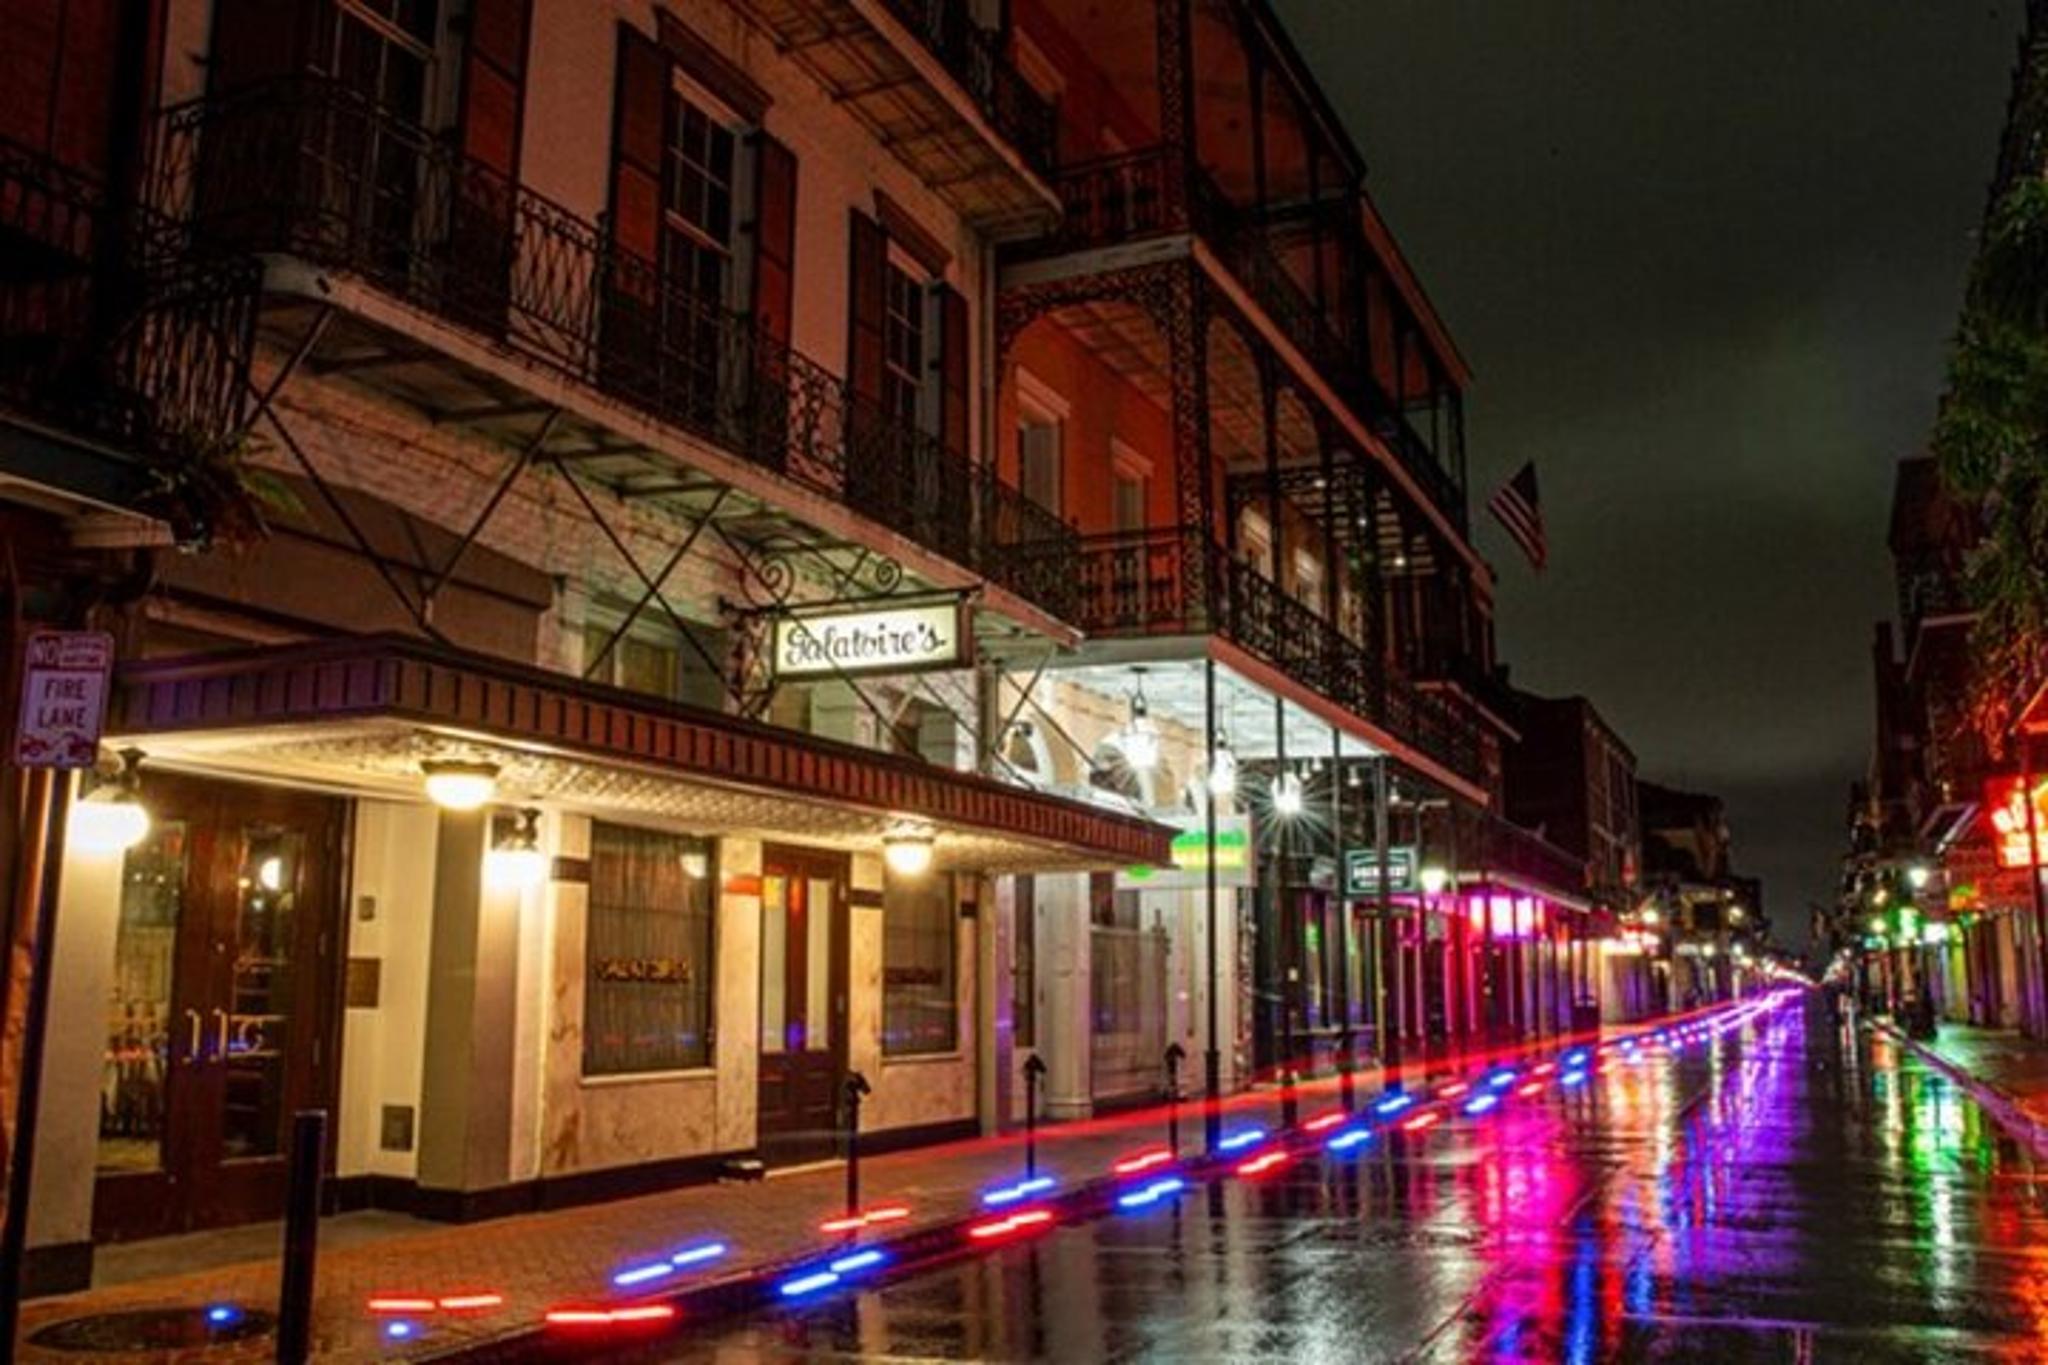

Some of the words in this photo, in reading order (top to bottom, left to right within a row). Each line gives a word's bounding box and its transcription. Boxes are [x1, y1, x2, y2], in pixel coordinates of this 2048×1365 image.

[786, 622, 946, 665] Galatoire's
[45, 679, 86, 700] FIRE
[38, 707, 86, 728] LANE
